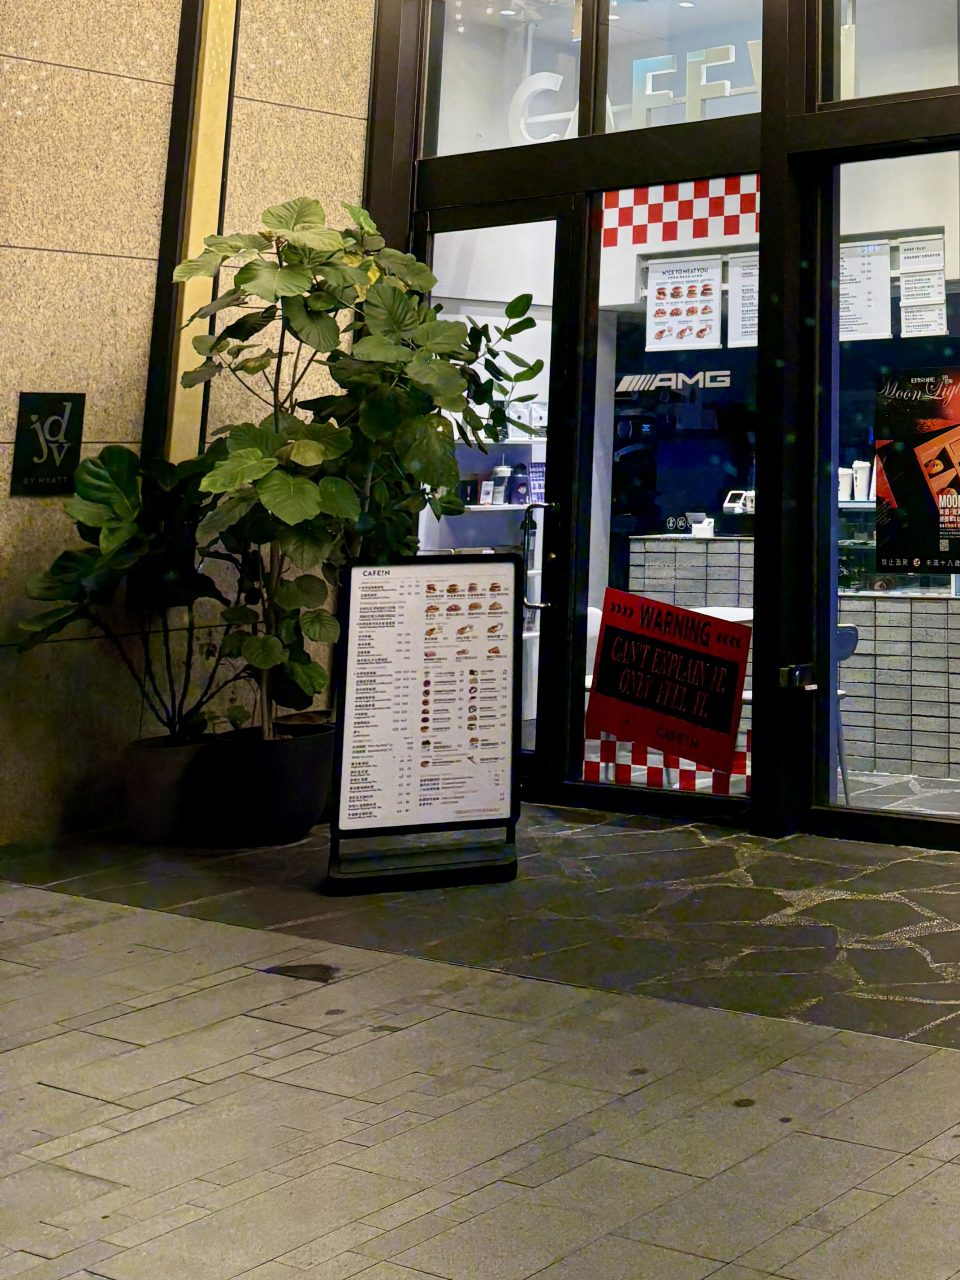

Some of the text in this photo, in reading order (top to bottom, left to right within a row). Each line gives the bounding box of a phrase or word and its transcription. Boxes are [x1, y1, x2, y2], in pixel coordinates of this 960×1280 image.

[649, 370, 731, 390] AMG
[880, 377, 922, 400] Moon
[23, 477, 35, 485] BY
[640, 605, 711, 648] WARNING
[651, 648, 709, 687] EXPLAIN
[619, 668, 651, 698] ONLY
